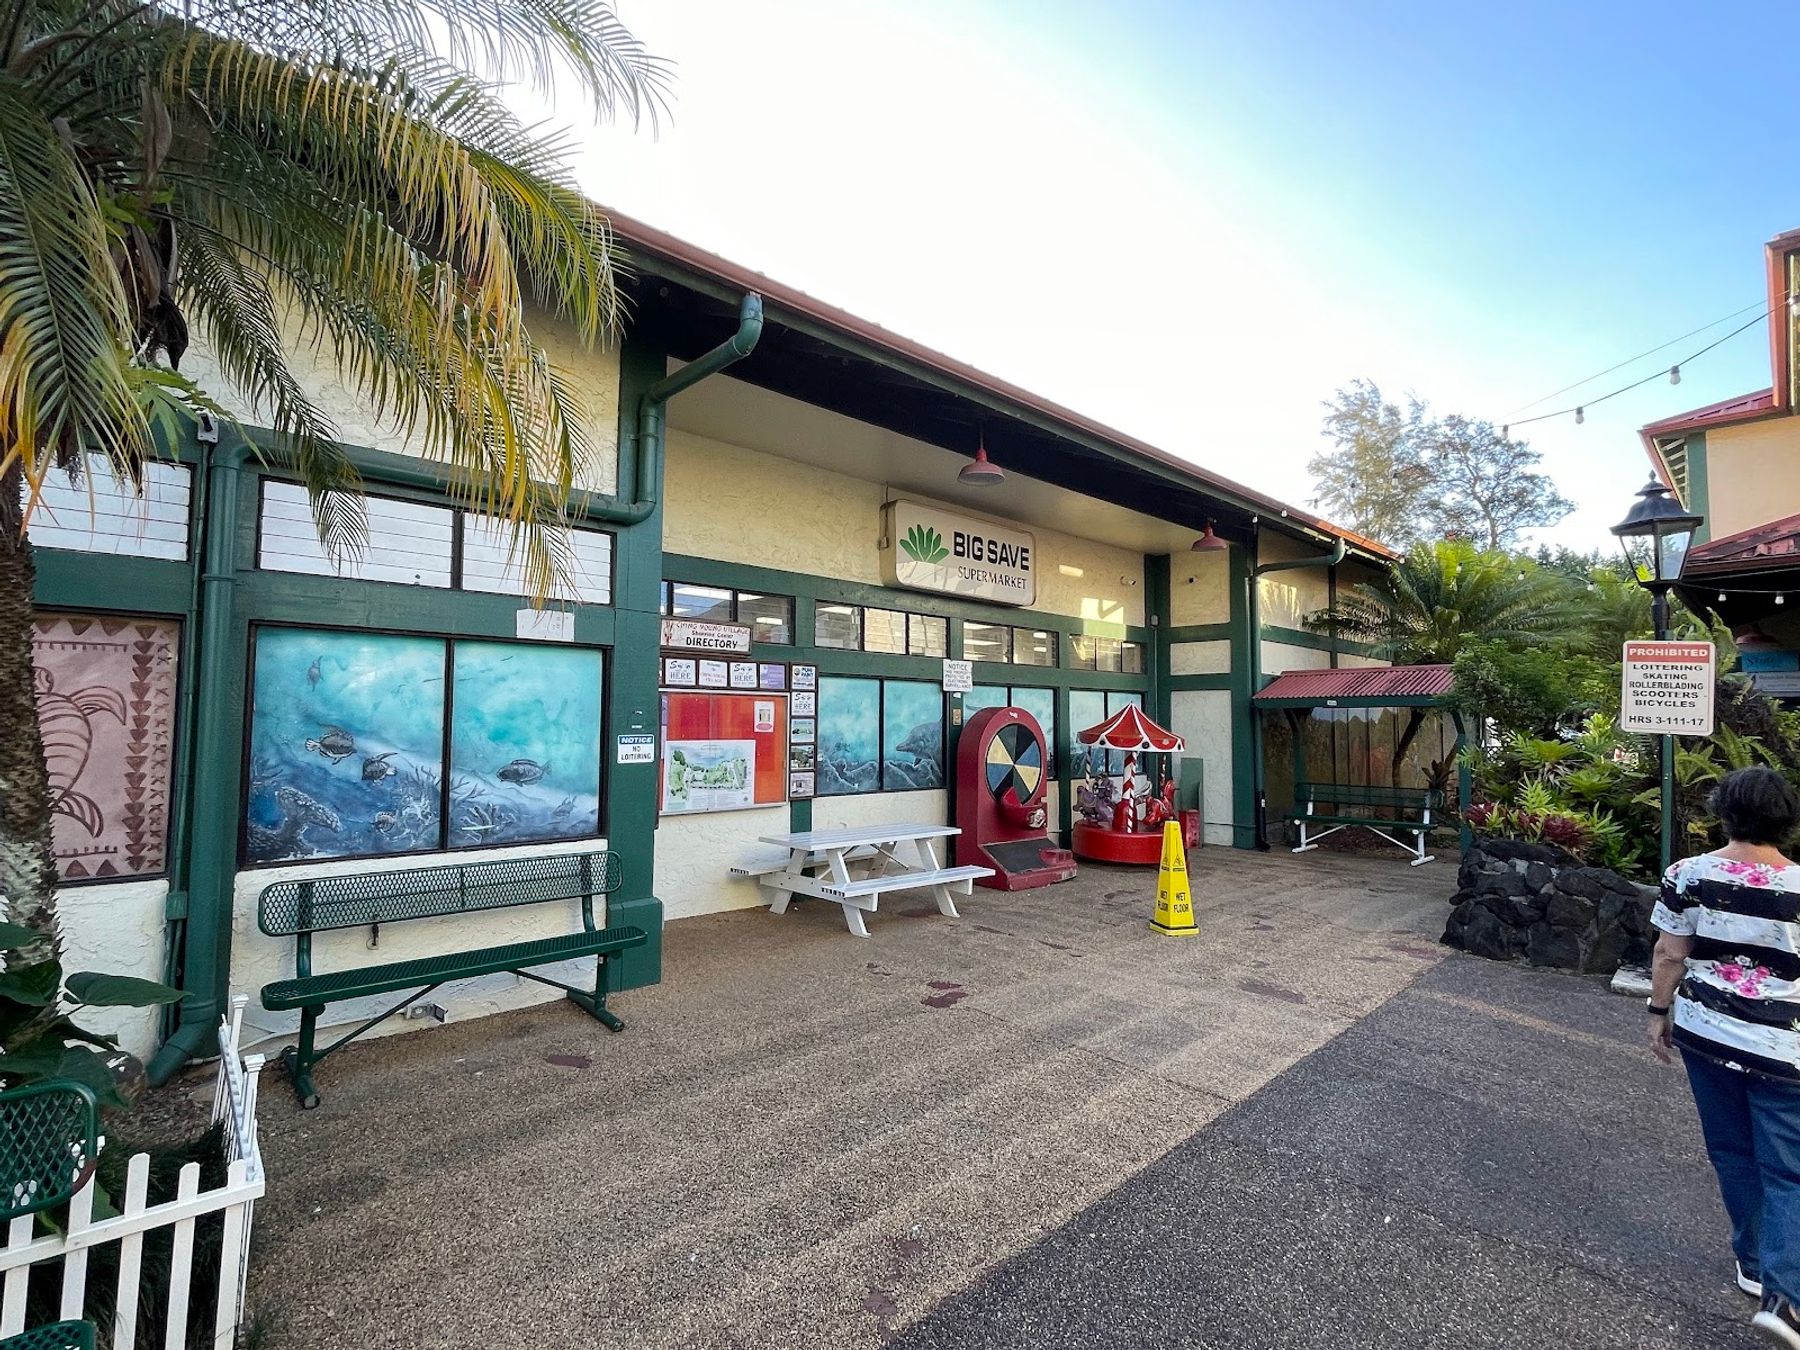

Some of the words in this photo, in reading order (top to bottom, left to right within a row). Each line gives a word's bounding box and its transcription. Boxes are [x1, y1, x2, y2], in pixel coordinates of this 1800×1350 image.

[953, 531, 983, 560] BIG
[987, 539, 1029, 570] SAVE
[958, 566, 1026, 589] SUPERMARKET
[686, 637, 737, 648] DIRECTORY
[1629, 648, 1707, 656] PROHIBITED
[670, 672, 691, 680] HERE
[1629, 681, 1704, 690] ROLLERBLADING
[1632, 690, 1698, 699] SCOOTERS
[1635, 700, 1695, 708] BICYCLES
[1629, 715, 1652, 724] HRS
[1655, 716, 1704, 726] 3-111-17
[1176, 892, 1185, 901] WET
[1174, 904, 1189, 913] FLOOR
